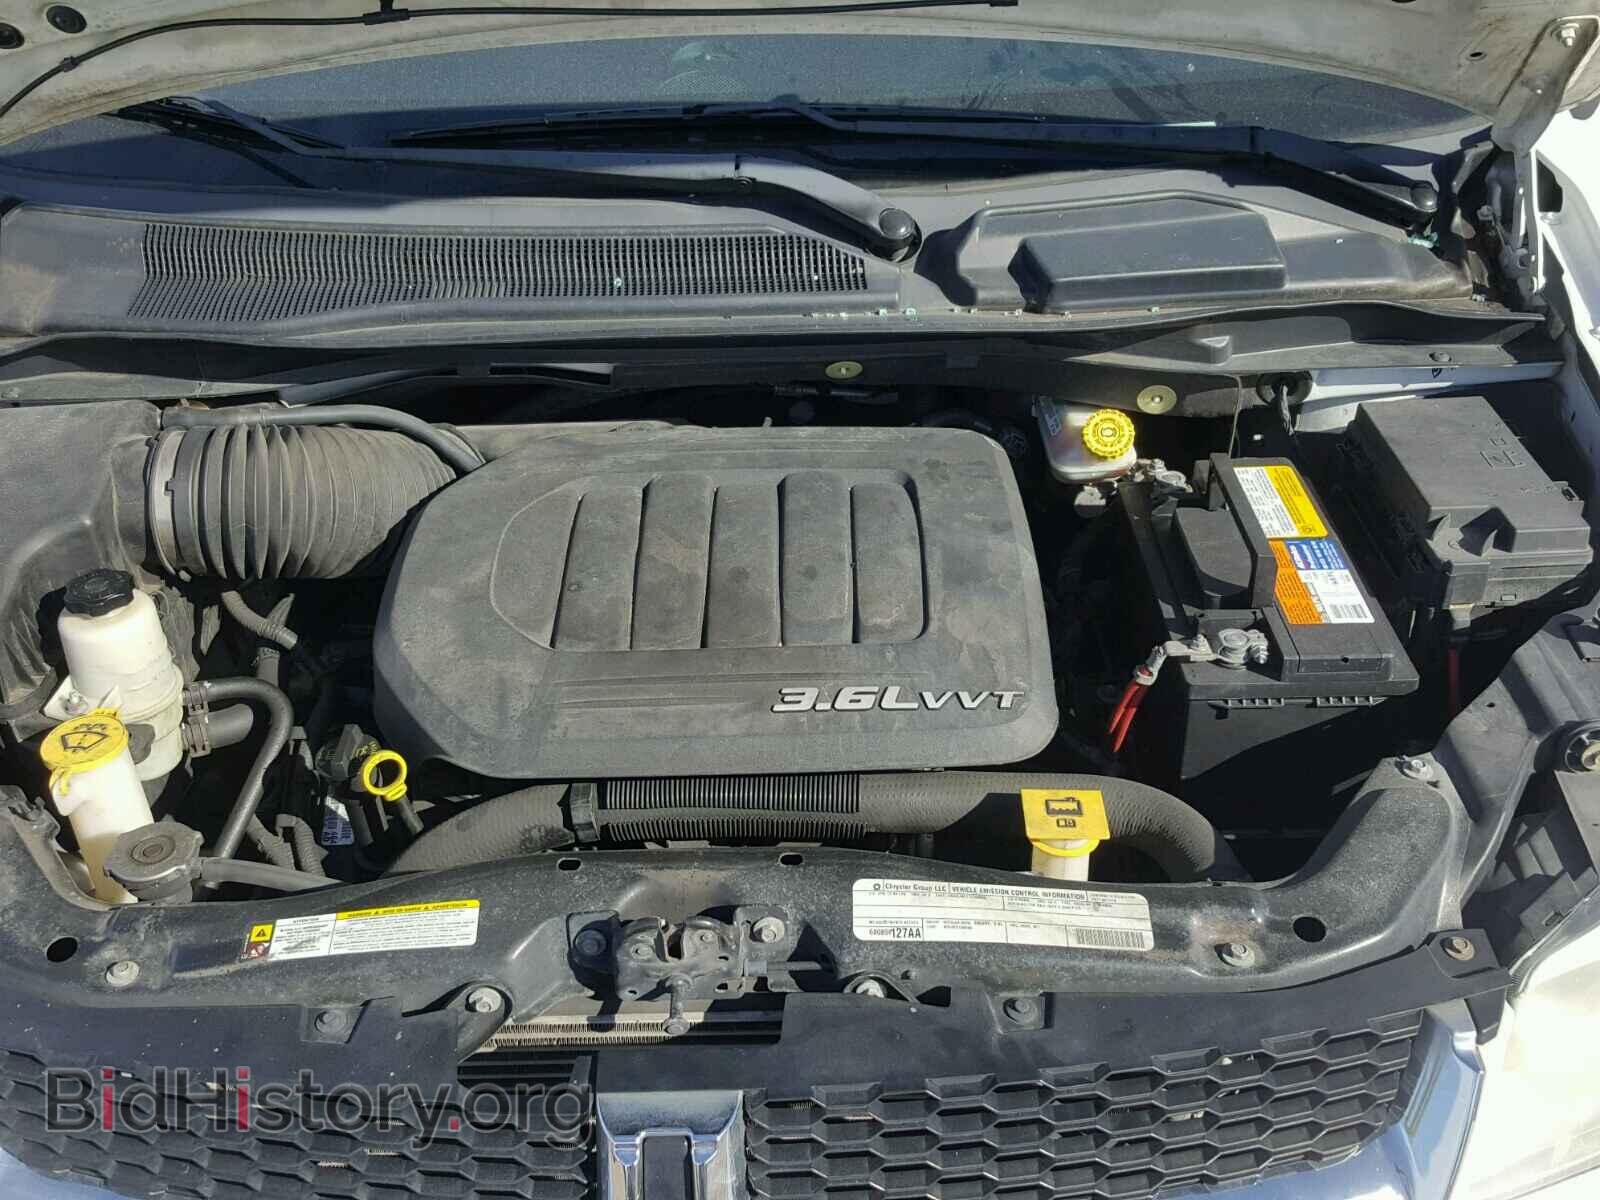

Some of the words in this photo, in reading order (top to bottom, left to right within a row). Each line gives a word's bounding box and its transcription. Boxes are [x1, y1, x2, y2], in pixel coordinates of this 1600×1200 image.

[952, 886, 977, 894] VEHICLE
[979, 887, 1009, 896] EMISSION
[1011, 889, 1039, 897] CONTROL
[1041, 890, 1086, 900] INFORMATION
